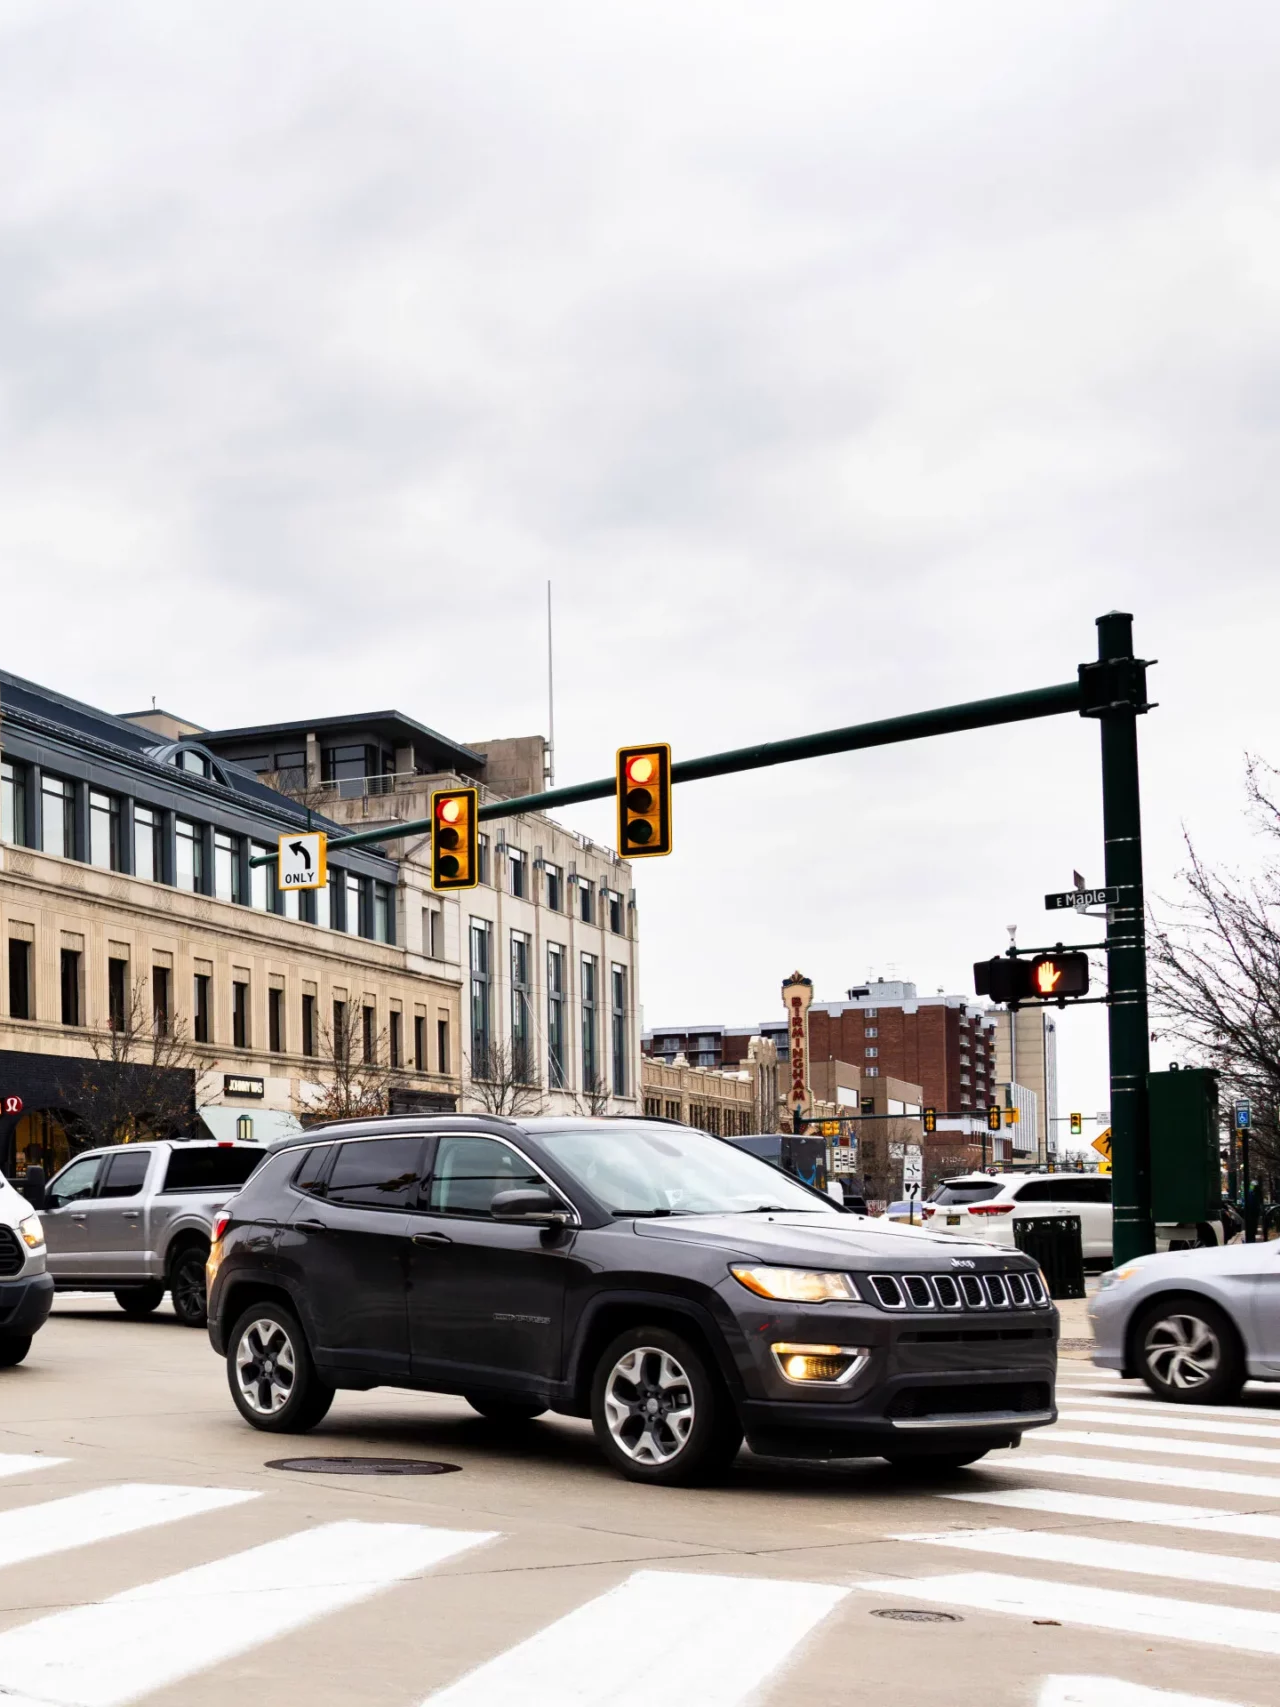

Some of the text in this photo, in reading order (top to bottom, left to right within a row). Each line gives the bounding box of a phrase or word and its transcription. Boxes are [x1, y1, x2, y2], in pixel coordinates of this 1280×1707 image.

[285, 872, 315, 884] ONLY
[1056, 890, 1106, 907] E Maple
[791, 996, 806, 1101] BIRMINGHAM
[950, 1257, 976, 1269] Jeep
